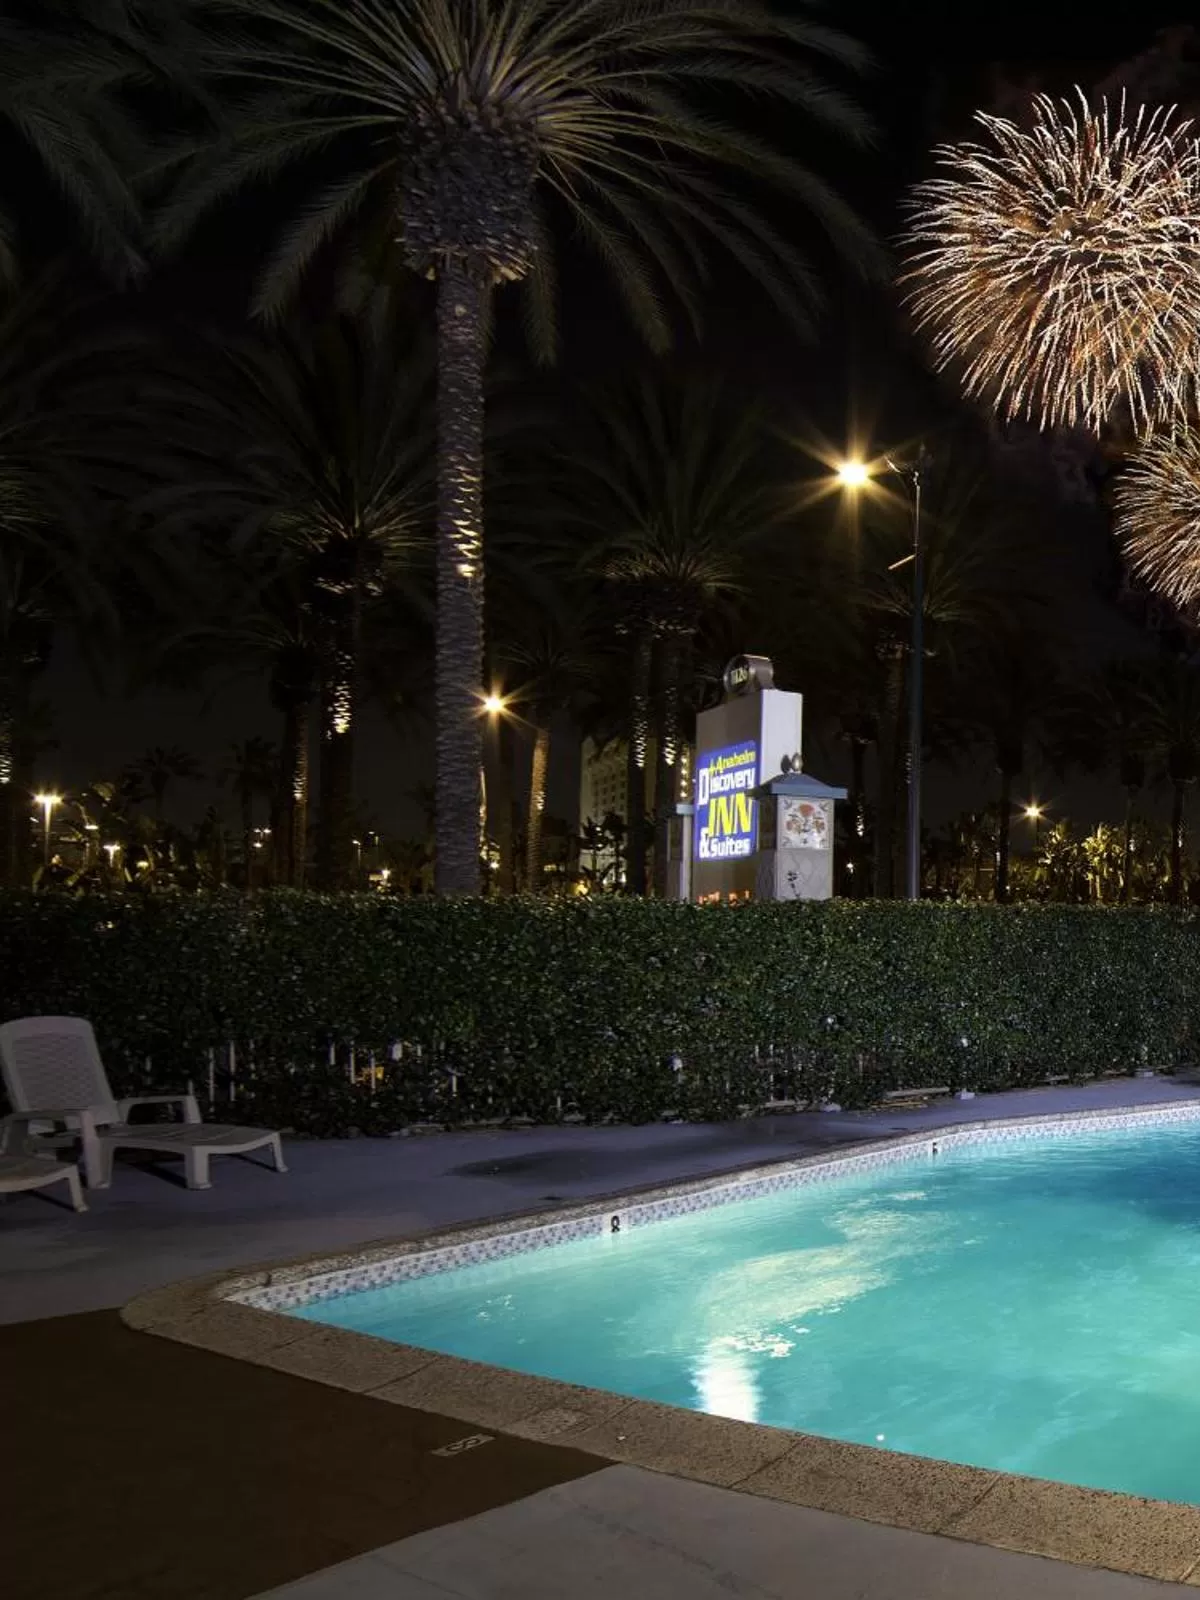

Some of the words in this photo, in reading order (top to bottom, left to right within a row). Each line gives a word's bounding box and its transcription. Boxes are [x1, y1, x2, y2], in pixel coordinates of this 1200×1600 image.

[698, 767, 756, 806] Discovery
[708, 792, 753, 838] INN
[711, 837, 751, 857] Suites
